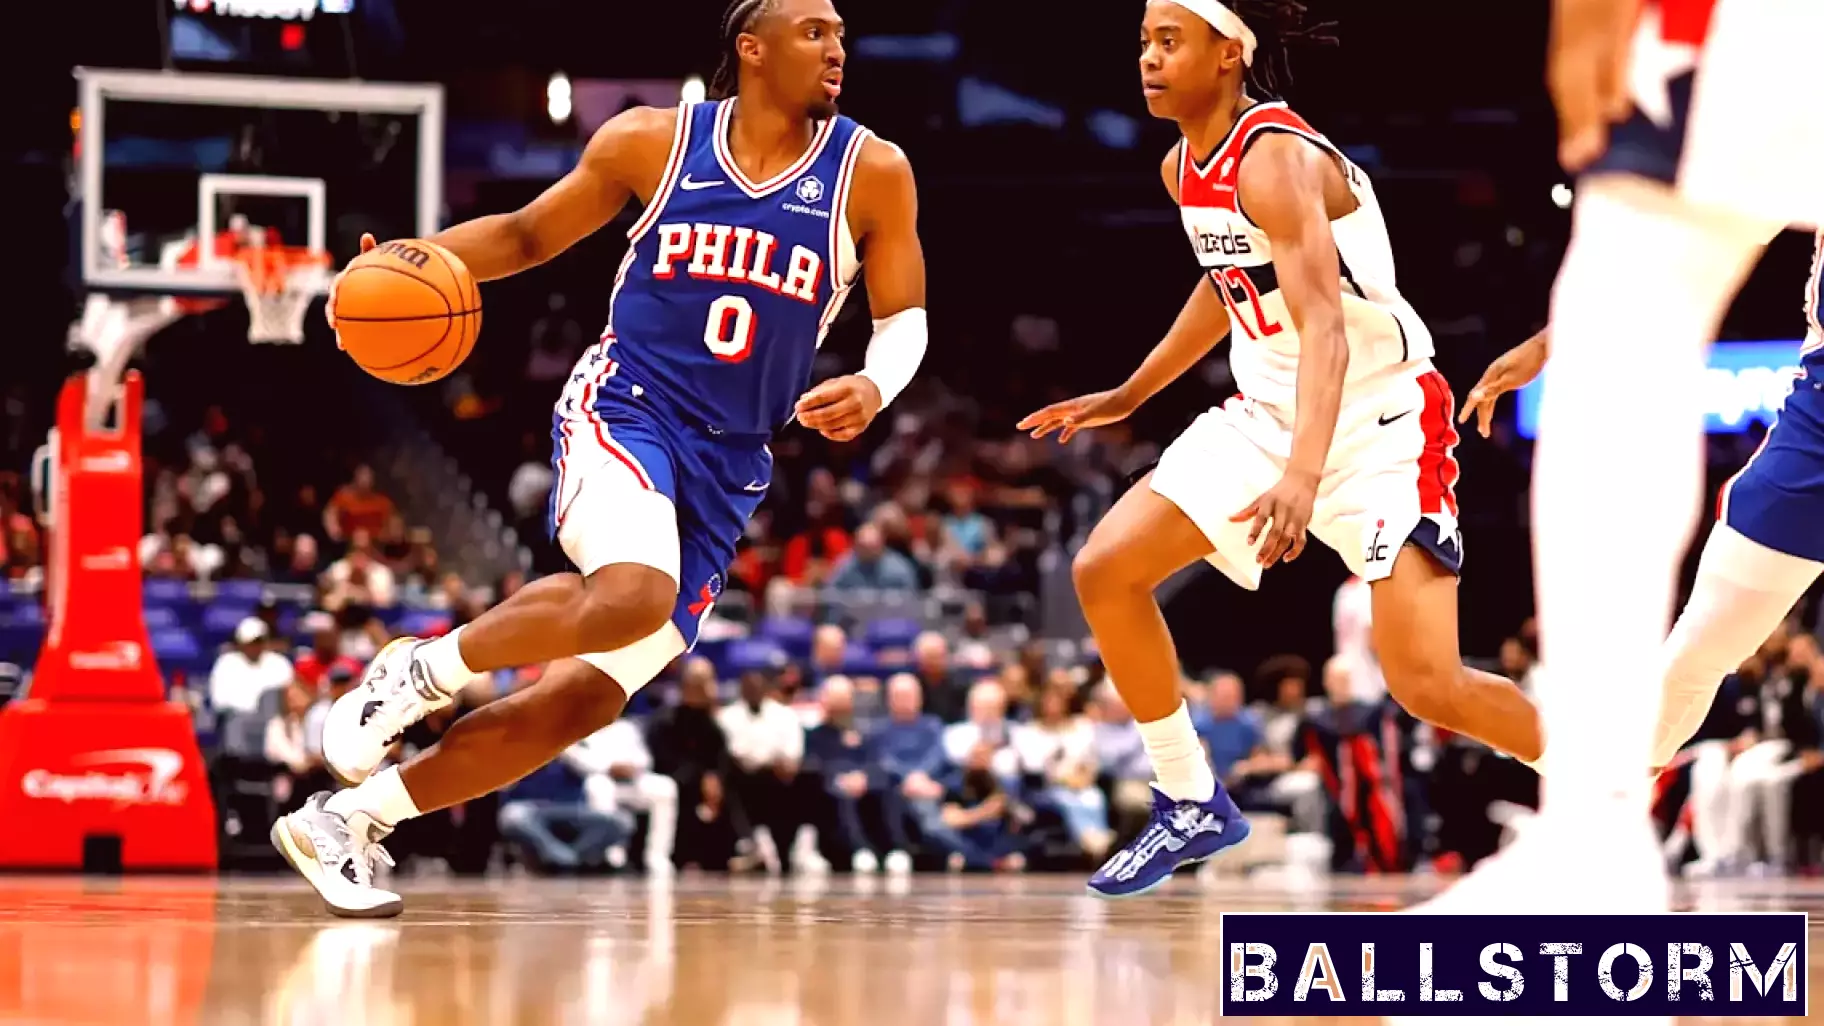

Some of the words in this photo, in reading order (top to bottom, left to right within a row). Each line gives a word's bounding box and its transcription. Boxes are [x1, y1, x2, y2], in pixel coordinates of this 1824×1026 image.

[782, 202, 830, 219] crypto.com
[652, 223, 824, 304] PHILA
[704, 295, 758, 364] 0
[1210, 266, 1284, 341] 12
